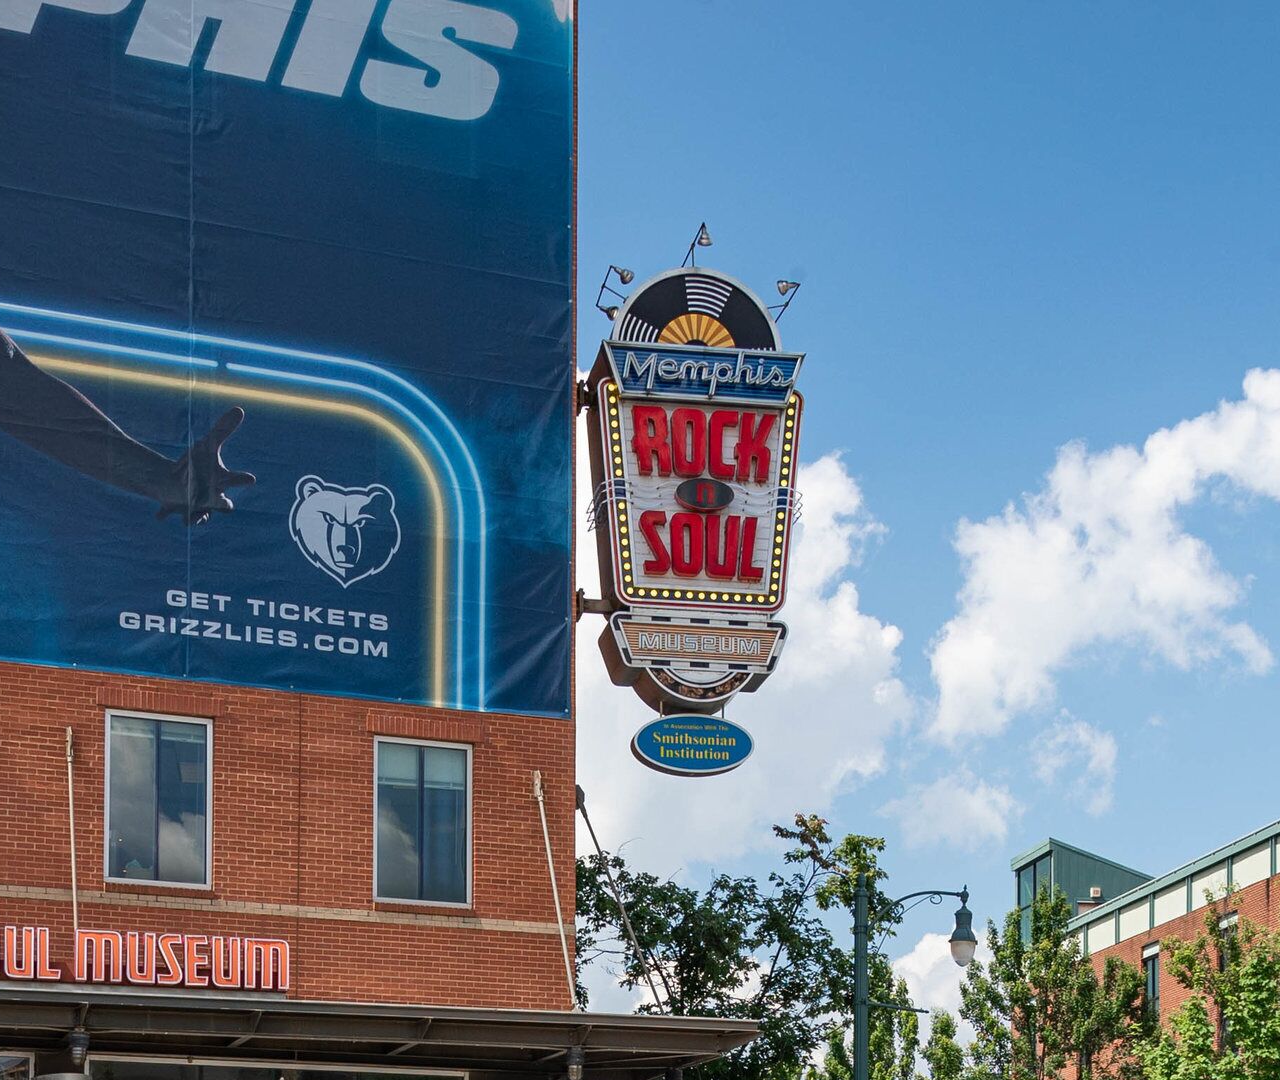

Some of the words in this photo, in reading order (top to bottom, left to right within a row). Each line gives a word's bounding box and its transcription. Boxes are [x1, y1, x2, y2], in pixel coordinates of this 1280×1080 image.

[623, 351, 794, 398] Memphis
[632, 405, 777, 483] ROCK
[696, 482, 715, 504] n
[639, 511, 764, 583] SOUL
[166, 589, 231, 612] GET
[247, 598, 389, 631] TICKETS
[119, 611, 388, 658] GRIZZLIES.COM
[652, 731, 736, 747] Smithsonian
[660, 746, 730, 760] Institution
[75, 928, 290, 991] MUSEUM
